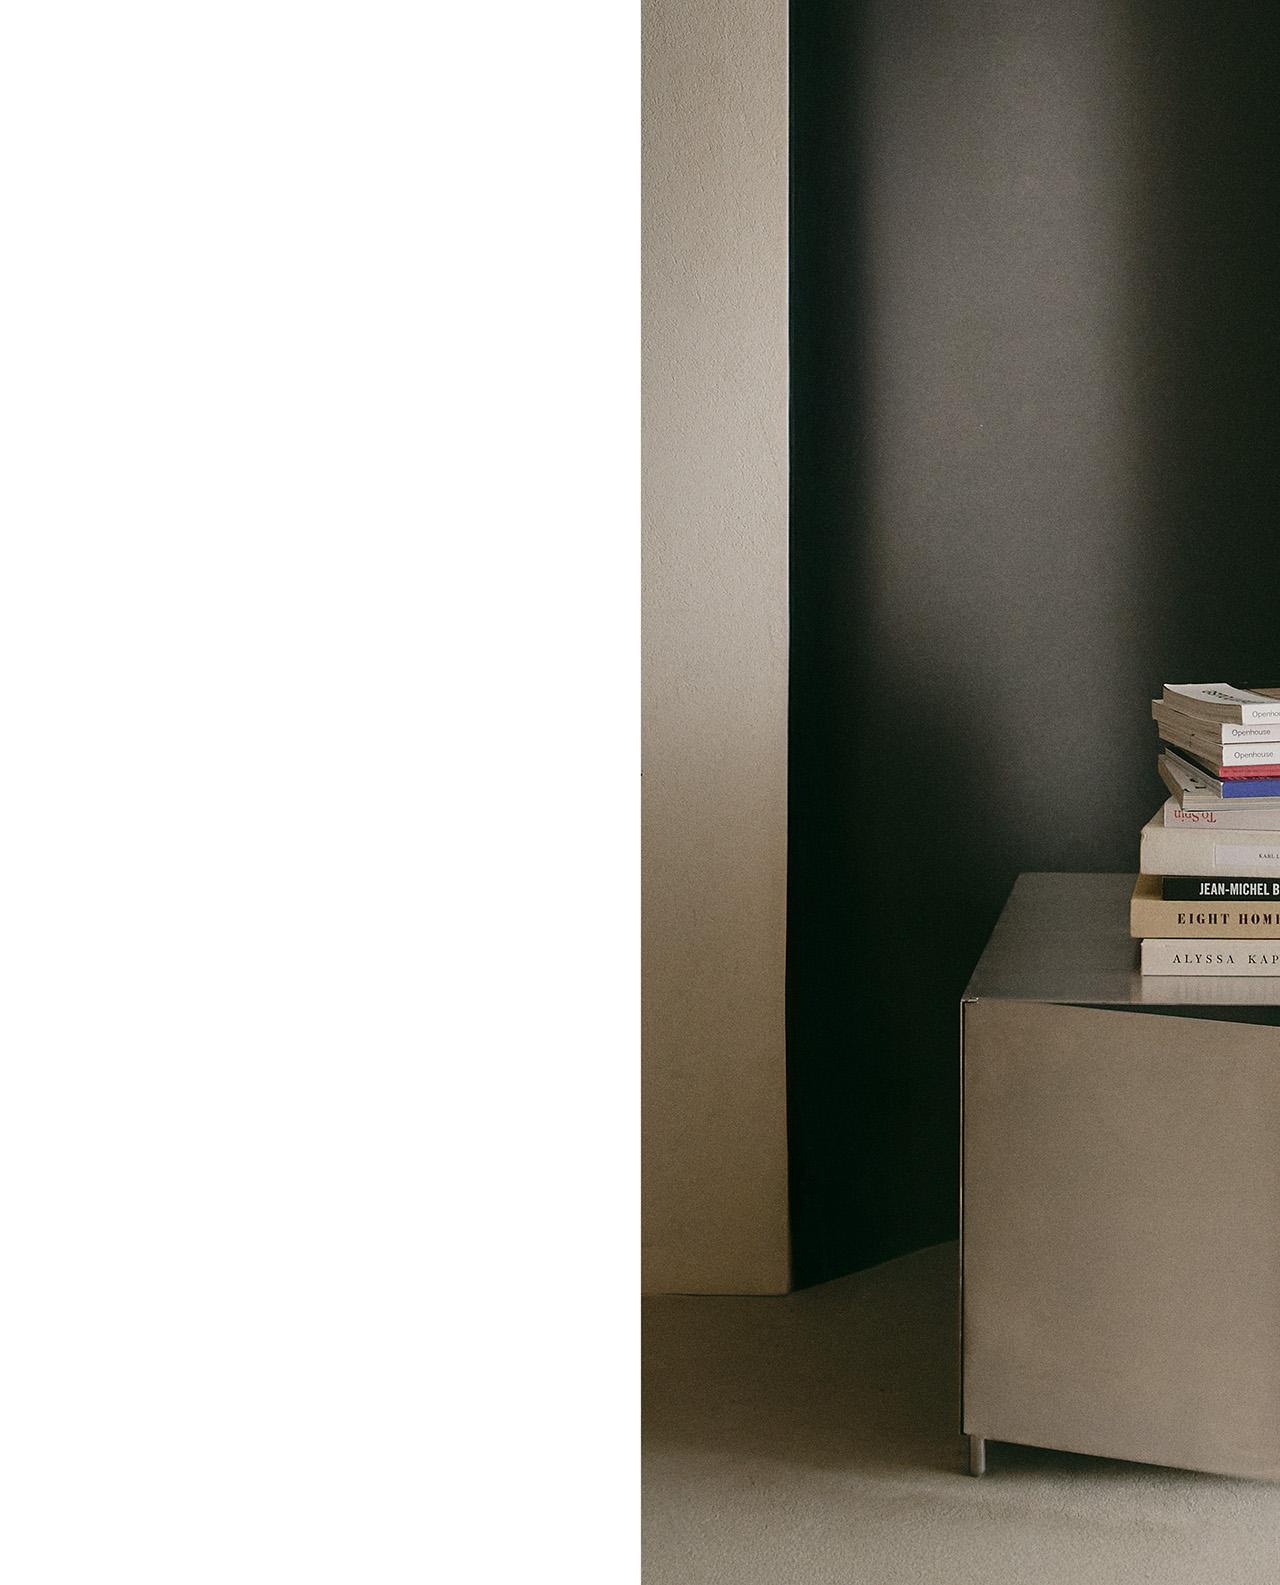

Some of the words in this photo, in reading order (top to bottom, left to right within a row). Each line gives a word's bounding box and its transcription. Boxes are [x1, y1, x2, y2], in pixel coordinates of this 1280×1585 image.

[1231, 729, 1271, 737] Openhouse
[1234, 751, 1274, 759] Openhouse
[1201, 812, 1217, 823] To
[1199, 882, 1270, 896] JEAN-MICHEL
[1177, 913, 1230, 925] EIGHT
[1172, 954, 1235, 964] ALYSSA
